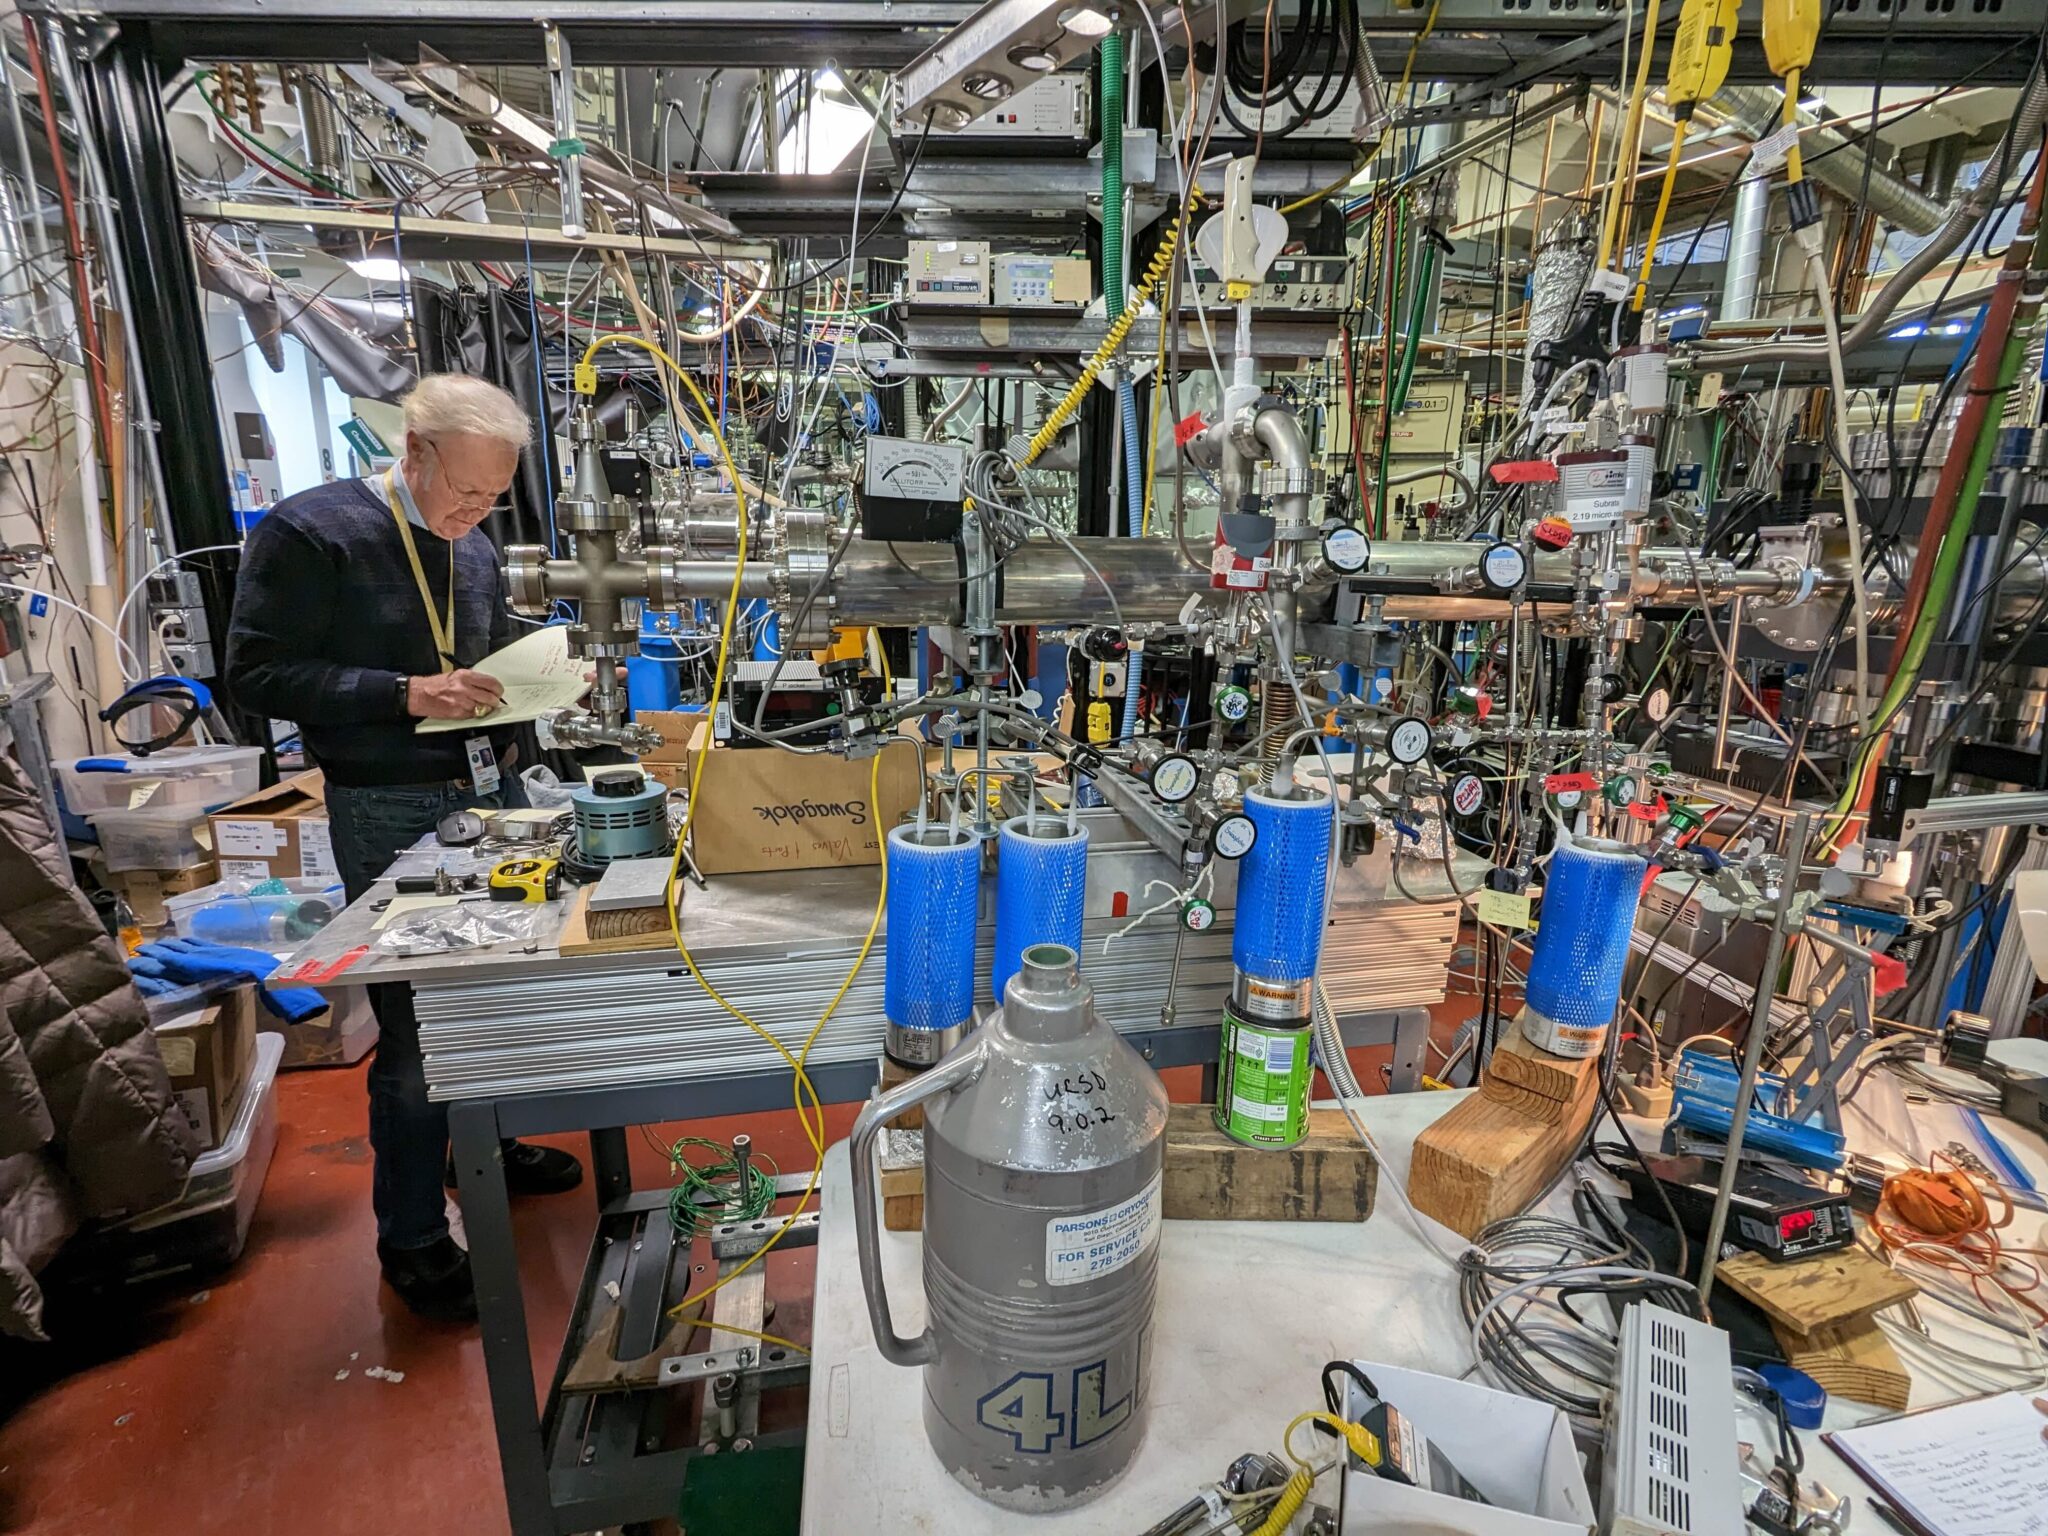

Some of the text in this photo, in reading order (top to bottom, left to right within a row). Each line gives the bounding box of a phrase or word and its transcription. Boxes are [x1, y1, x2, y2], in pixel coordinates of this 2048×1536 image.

[322, 448, 333, 471] 8
[1572, 512, 1591, 521] 2.19
[753, 799, 866, 826] Swagelok
[1258, 989, 1297, 1000] WARNING
[1048, 1106, 1116, 1135] 9.0.2
[1055, 1216, 1110, 1234] PARSONS
[1058, 1250, 1085, 1263] FOR
[1090, 1230, 1138, 1258] SERVICE
[1090, 1239, 1140, 1272] 278-2050
